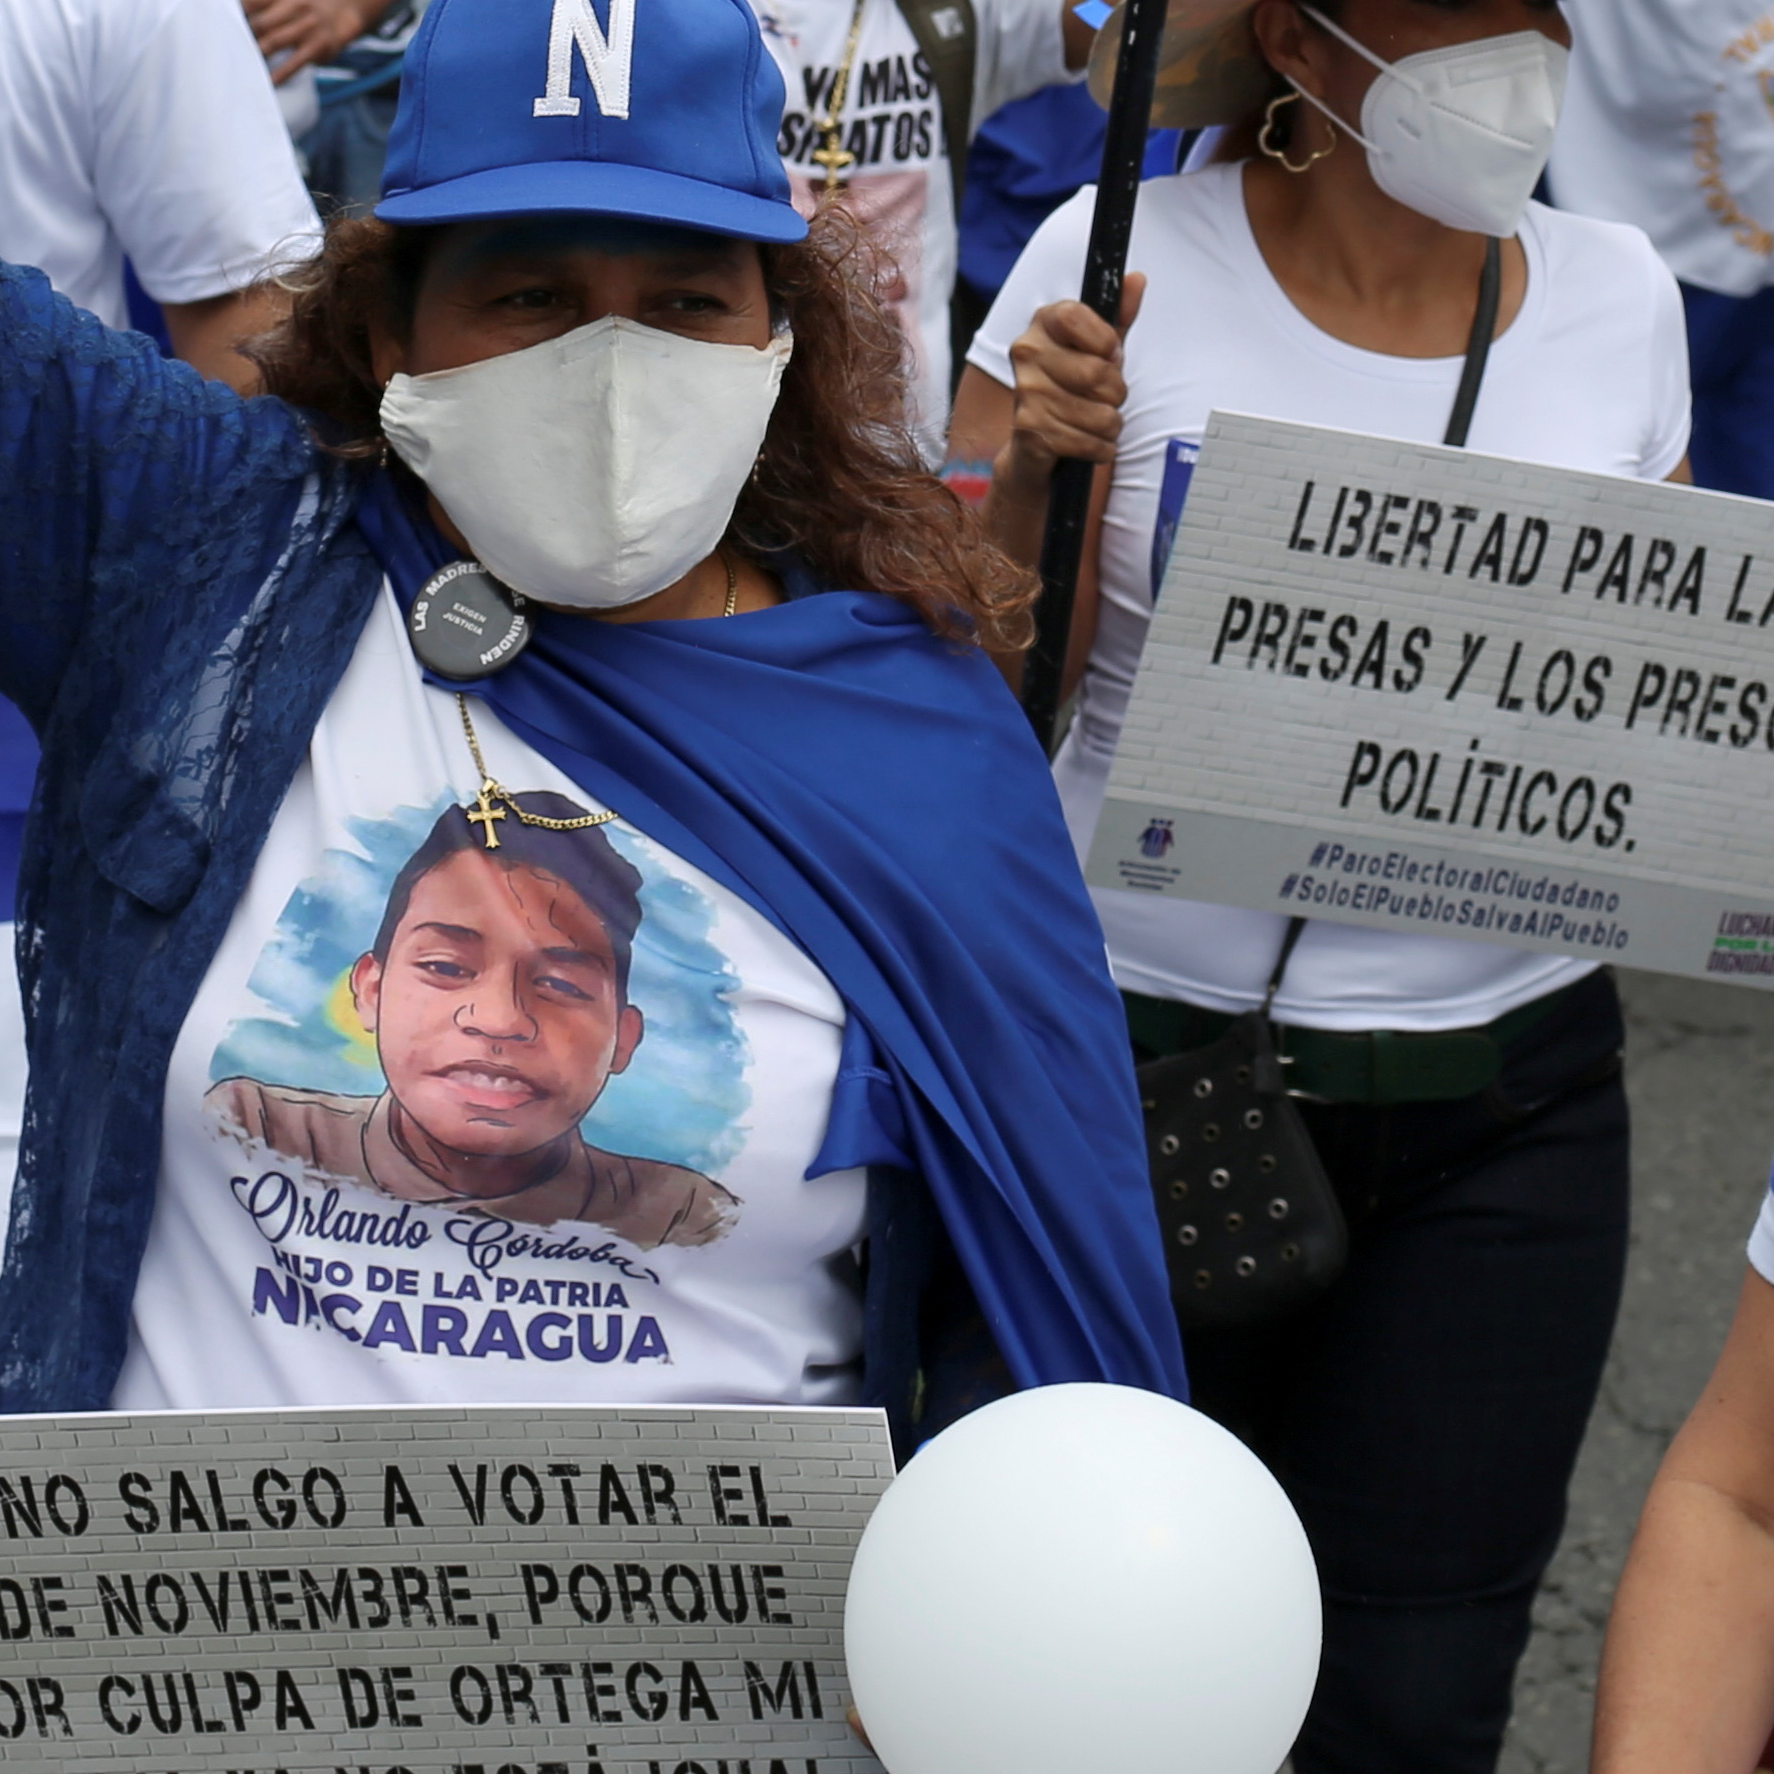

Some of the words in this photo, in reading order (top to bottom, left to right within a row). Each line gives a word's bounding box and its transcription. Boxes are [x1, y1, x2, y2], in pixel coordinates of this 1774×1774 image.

[1288, 479, 1549, 589] LIBERTAD
[1561, 523, 1707, 618] PARA
[413, 599, 430, 633] LAS
[425, 561, 489, 597] MADRES
[442, 610, 484, 637] JUSTICIA
[451, 601, 488, 624] EXIGEN
[479, 613, 526, 666] RINDEN
[1211, 595, 1432, 696] PRESAS
[1446, 632, 1487, 702] Y
[1497, 639, 1613, 725] LOS
[1340, 737, 1639, 855] POLÍTICOS.
[1278, 873, 1631, 951] #SoloElPuebloSalvaAlPueblo
[1307, 840, 1621, 914] #ParoElectoralCiudadano
[230, 1171, 431, 1252] Orlando
[271, 1243, 354, 1287] HIJO
[366, 1264, 419, 1297] DE
[433, 1270, 482, 1303] LA
[496, 1276, 630, 1309] PATRIA
[251, 1265, 674, 1366] NICARAGUA
[117, 1465, 348, 1536] SALGO
[382, 1464, 425, 1528] A
[446, 1462, 684, 1527] VOTAR
[706, 1464, 793, 1528] EL
[95, 1563, 501, 1641] NOVIEMBRE,
[519, 1562, 794, 1625] PORQUE
[97, 1669, 316, 1737] CULPA
[337, 1665, 423, 1729] DE
[448, 1660, 720, 1727] ORTEGA
[743, 1659, 824, 1721] MI
